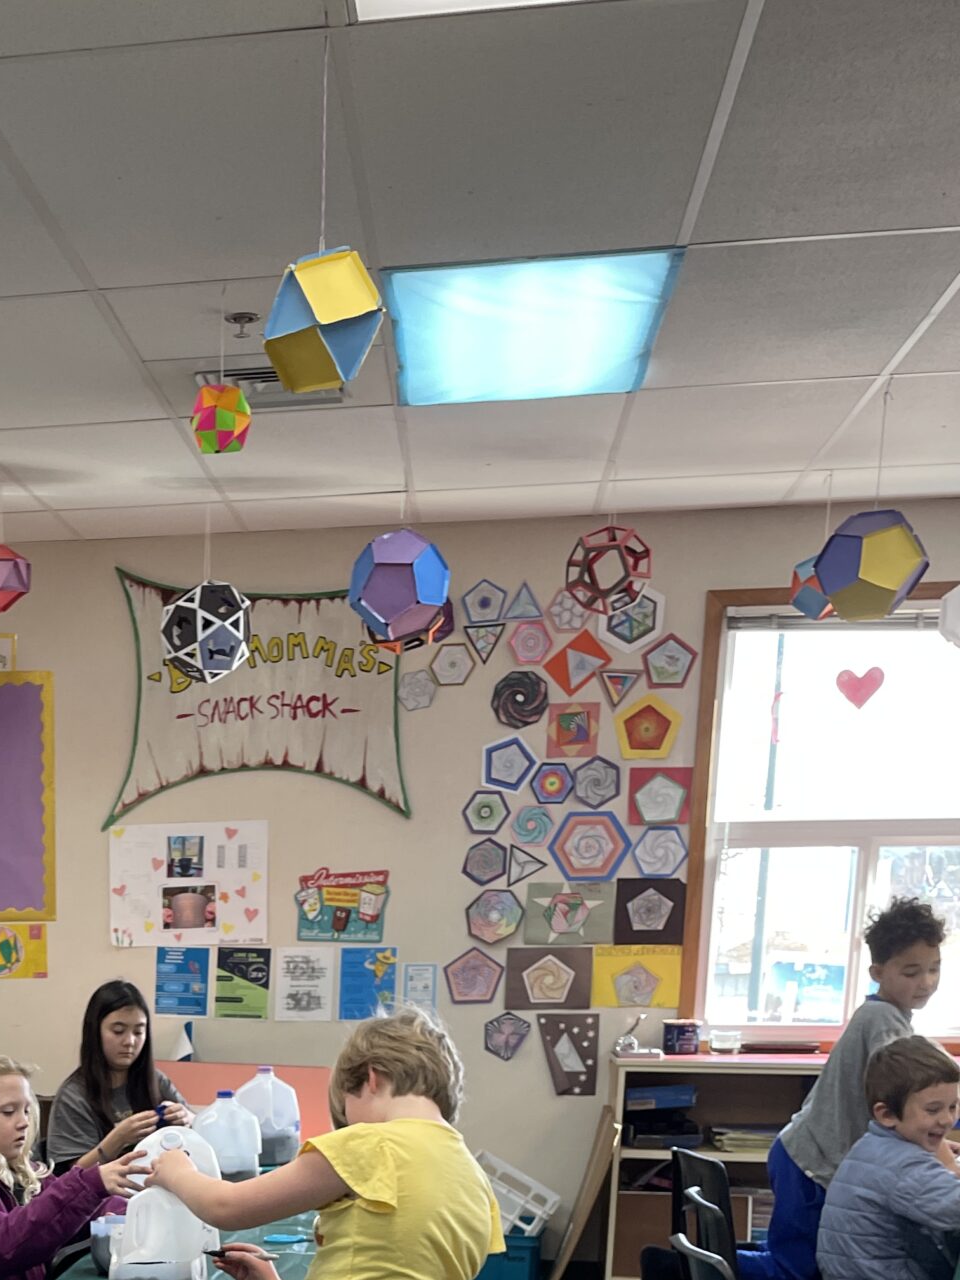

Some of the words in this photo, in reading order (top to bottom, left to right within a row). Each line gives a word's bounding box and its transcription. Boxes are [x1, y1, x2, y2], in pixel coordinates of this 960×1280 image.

[248, 631, 379, 678] MOMMA'S
[196, 694, 264, 727] SNACK
[266, 690, 341, 721] SHACK
